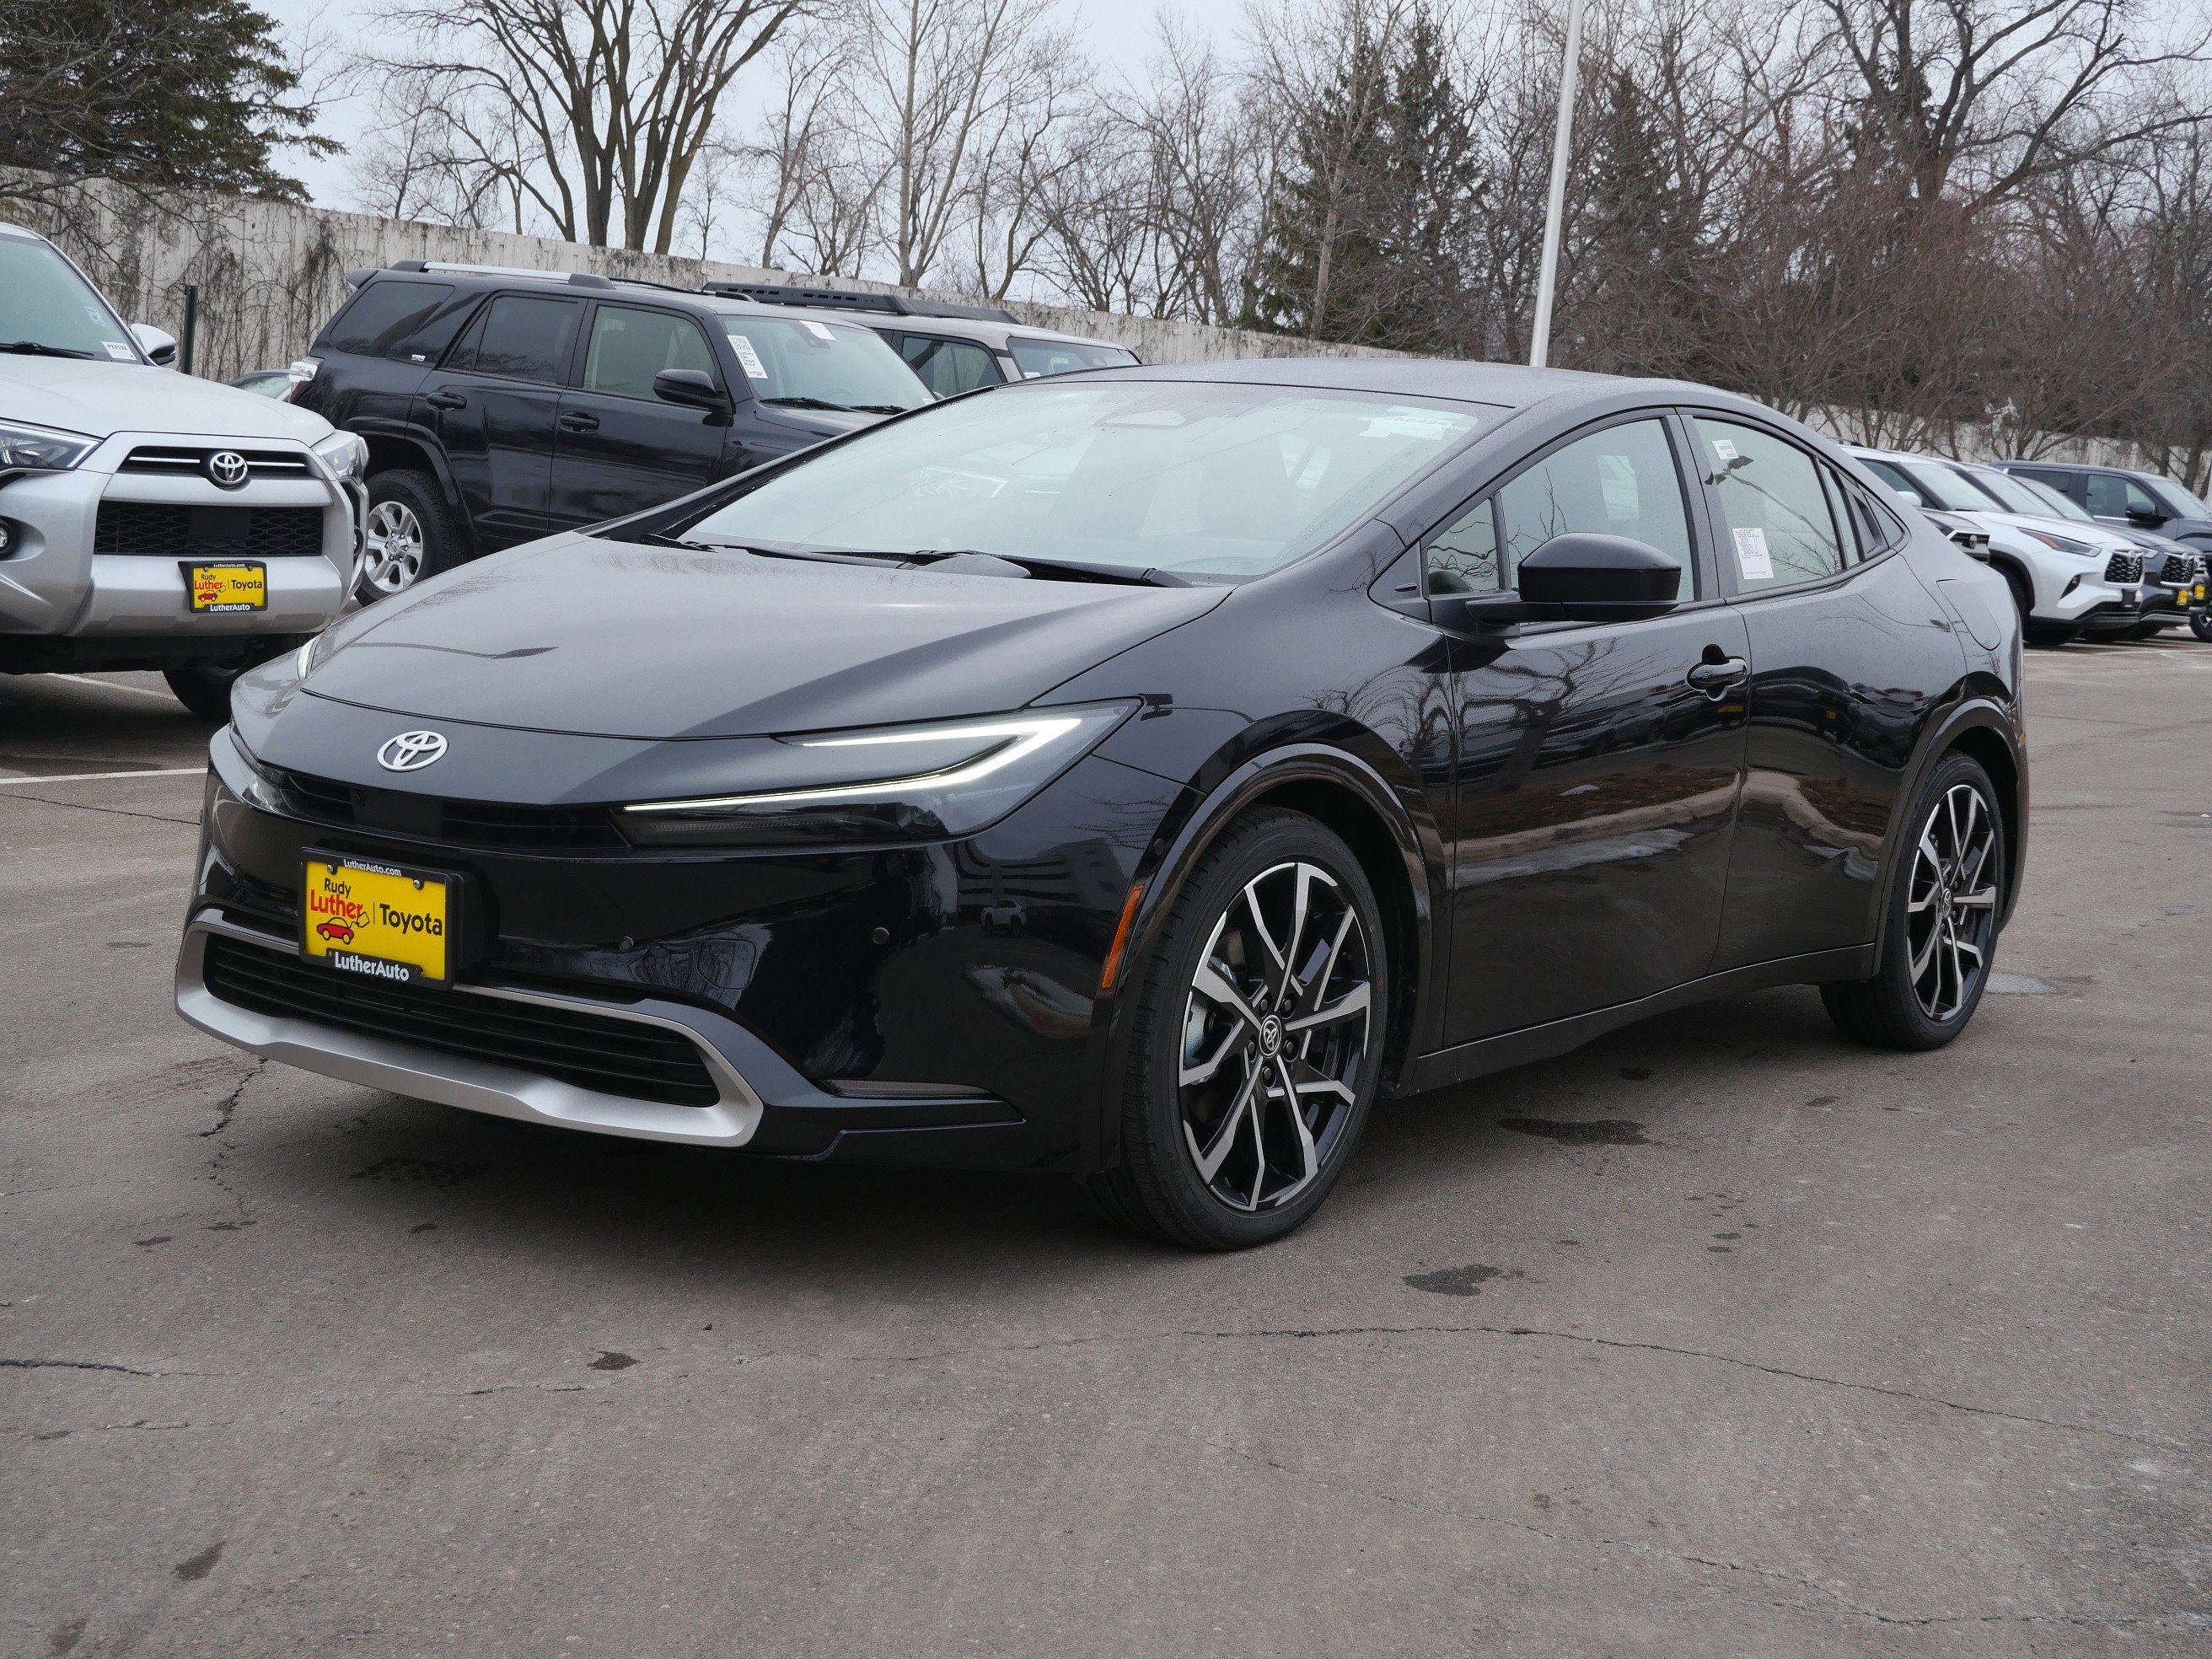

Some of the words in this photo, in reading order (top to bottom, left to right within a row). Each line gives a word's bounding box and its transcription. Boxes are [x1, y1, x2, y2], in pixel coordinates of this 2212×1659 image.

[194, 580, 223, 590] Luther
[201, 573, 217, 582] Rudy
[231, 579, 263, 591] Toyota
[210, 604, 250, 612] LutherAuto
[343, 858, 402, 877] LutherAuto.com
[324, 878, 352, 899] Rudy
[310, 889, 364, 920] Luther
[379, 903, 443, 937] Toyota
[335, 951, 410, 981] LutherAuto
